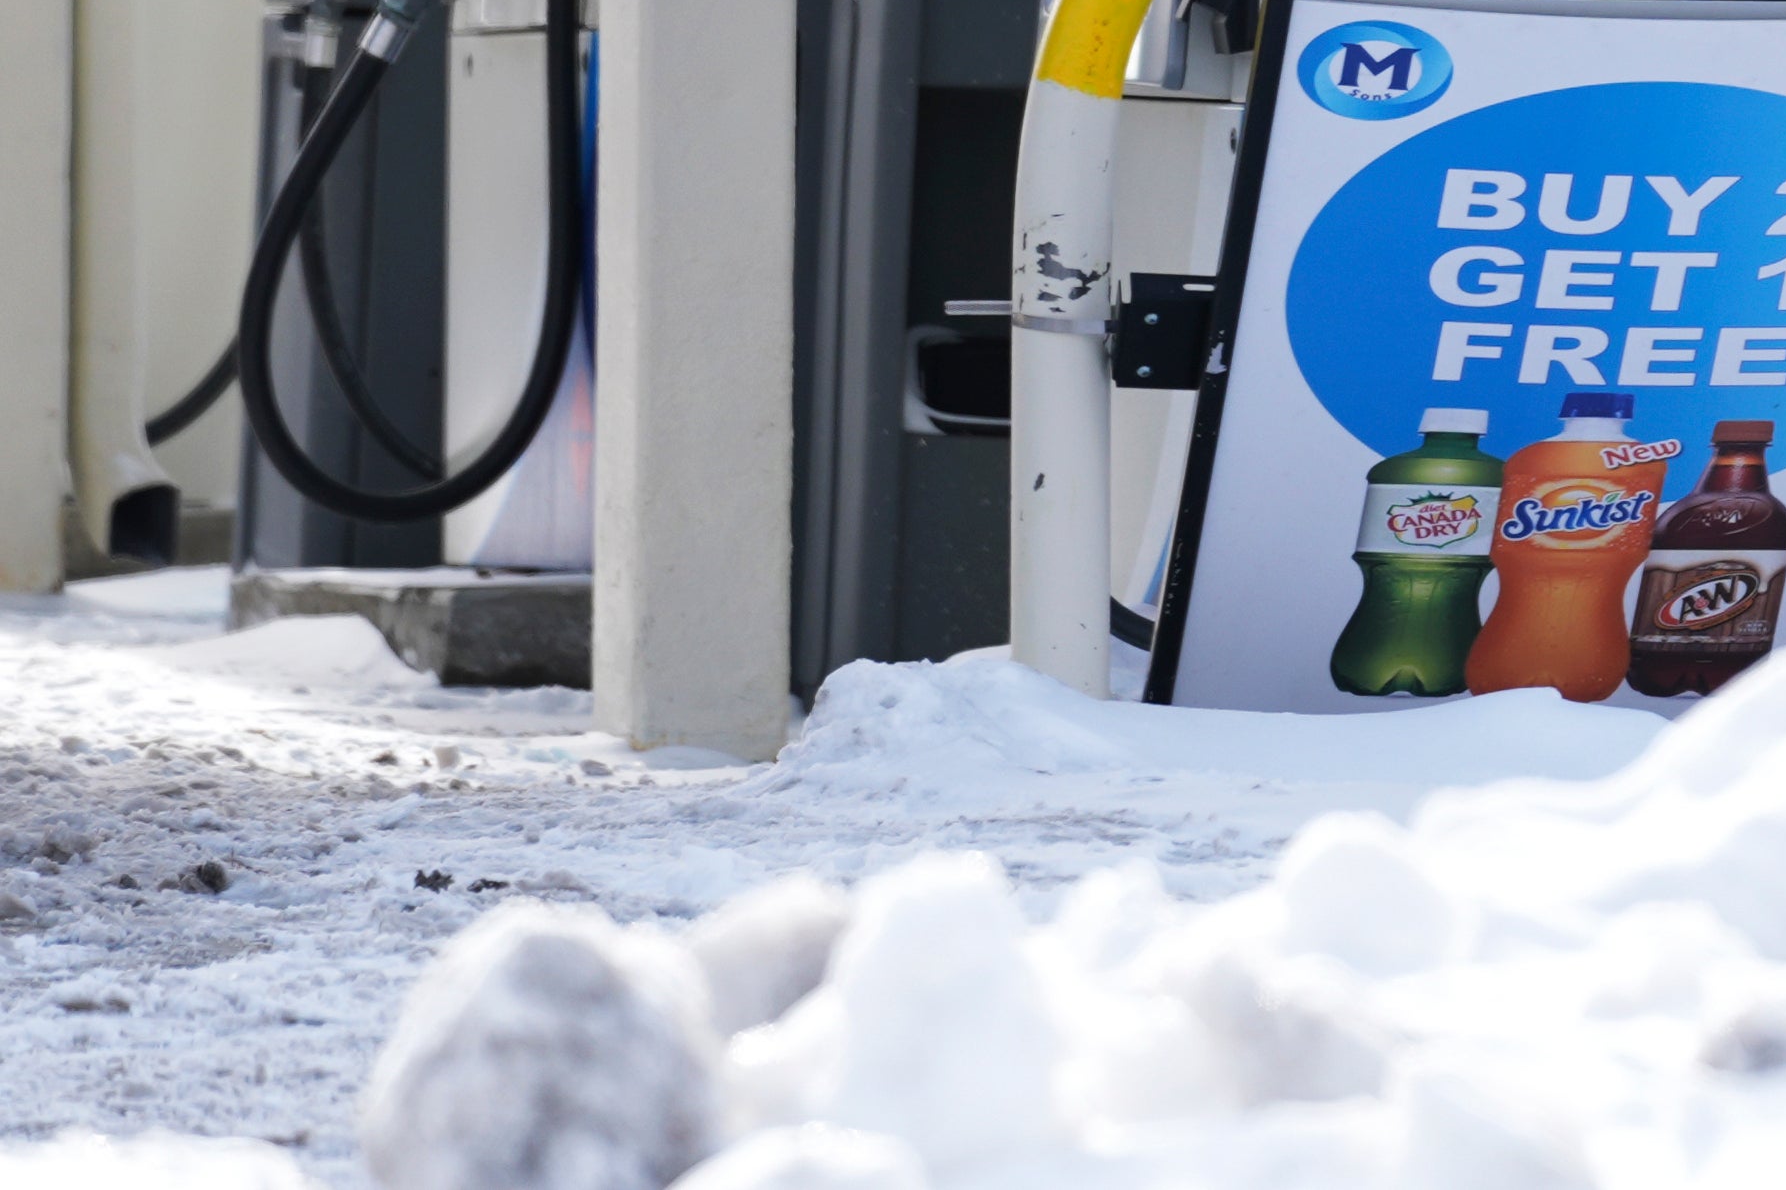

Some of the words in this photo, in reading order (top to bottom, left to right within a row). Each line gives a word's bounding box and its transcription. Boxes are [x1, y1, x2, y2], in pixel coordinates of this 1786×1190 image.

[1337, 42, 1423, 91] M
[1349, 88, 1393, 102] Sons
[1436, 168, 1741, 236] BUY
[1428, 244, 1716, 312] GET
[1602, 440, 1680, 467] New
[1386, 507, 1483, 533] CANADA
[1413, 521, 1462, 540] DRY
[1502, 491, 1653, 540] Sunkist
